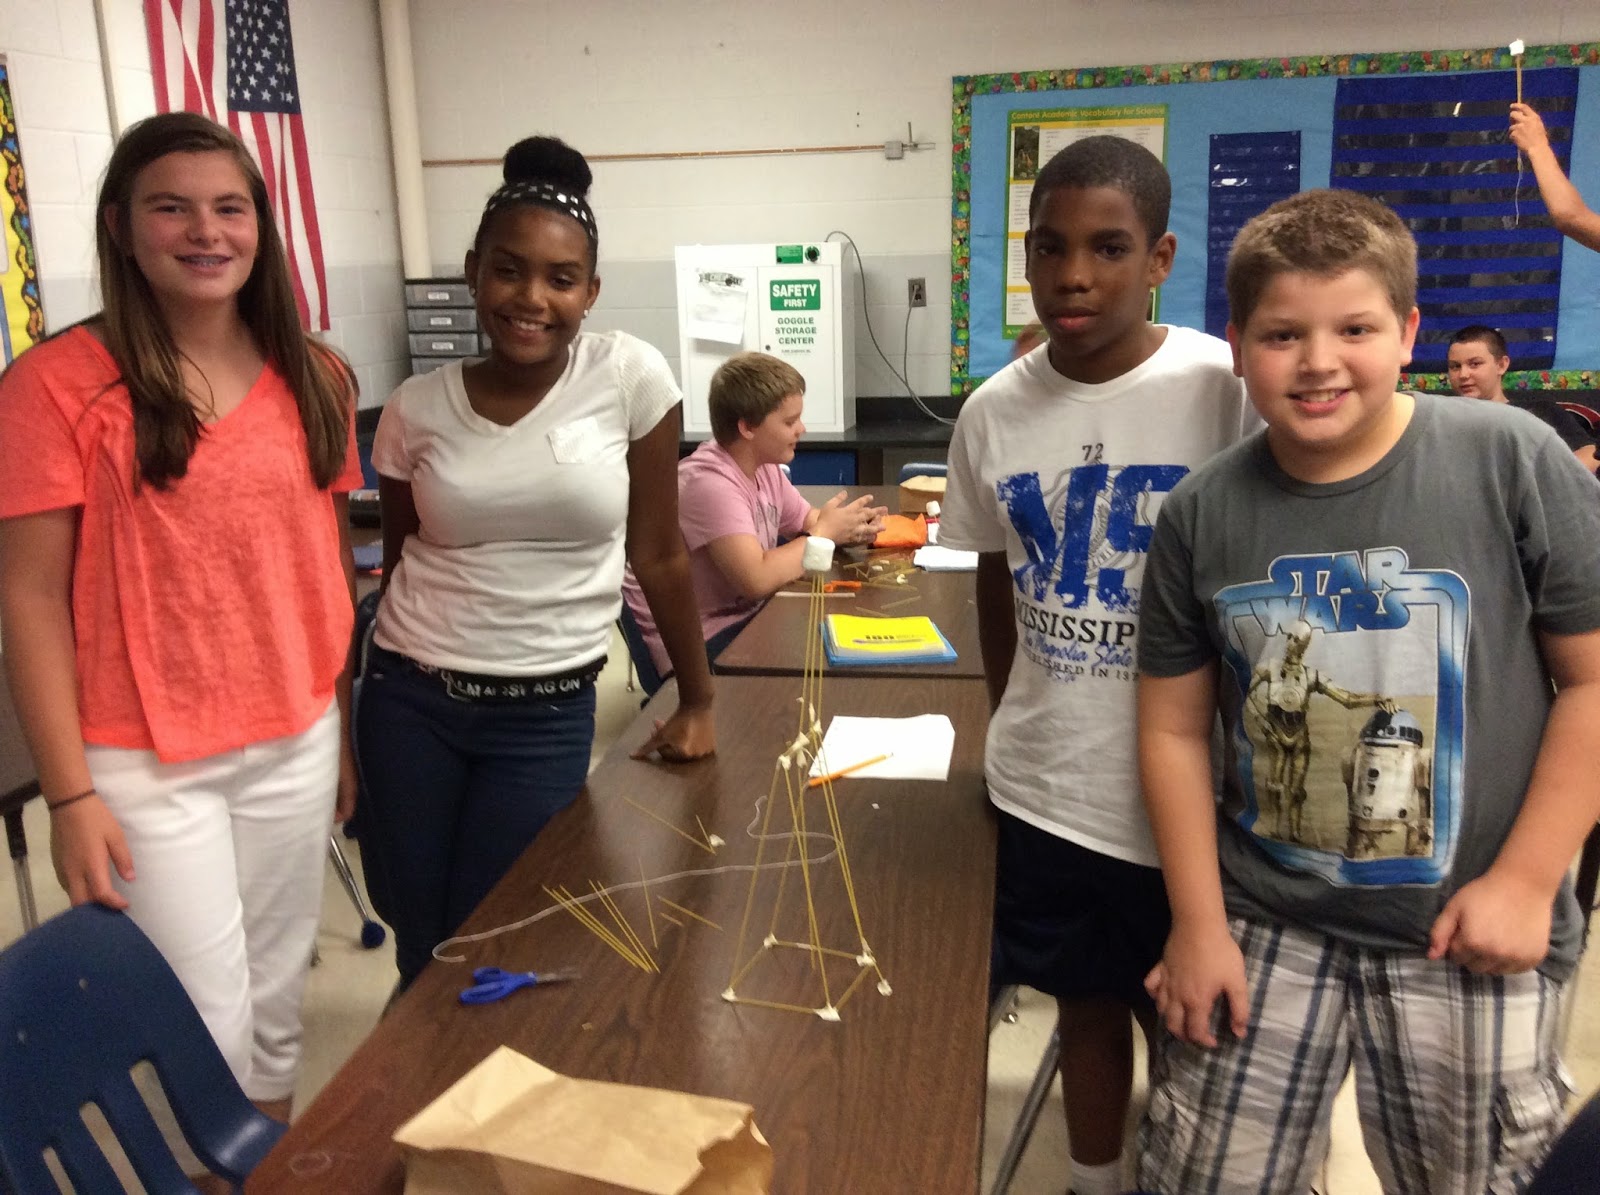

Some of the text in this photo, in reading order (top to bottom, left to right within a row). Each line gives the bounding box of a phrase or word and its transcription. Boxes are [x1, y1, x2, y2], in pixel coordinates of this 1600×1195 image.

[1080, 107, 1122, 118] Vocabulary
[772, 283, 817, 298] SAFETY
[783, 298, 807, 308] FIRST
[777, 316, 815, 325] GOGGLE
[774, 326, 817, 335] STORAGE
[778, 336, 815, 345] CENTER
[1082, 443, 1104, 462] 72
[1269, 546, 1409, 598] STAR
[1249, 592, 1412, 637] WARS
